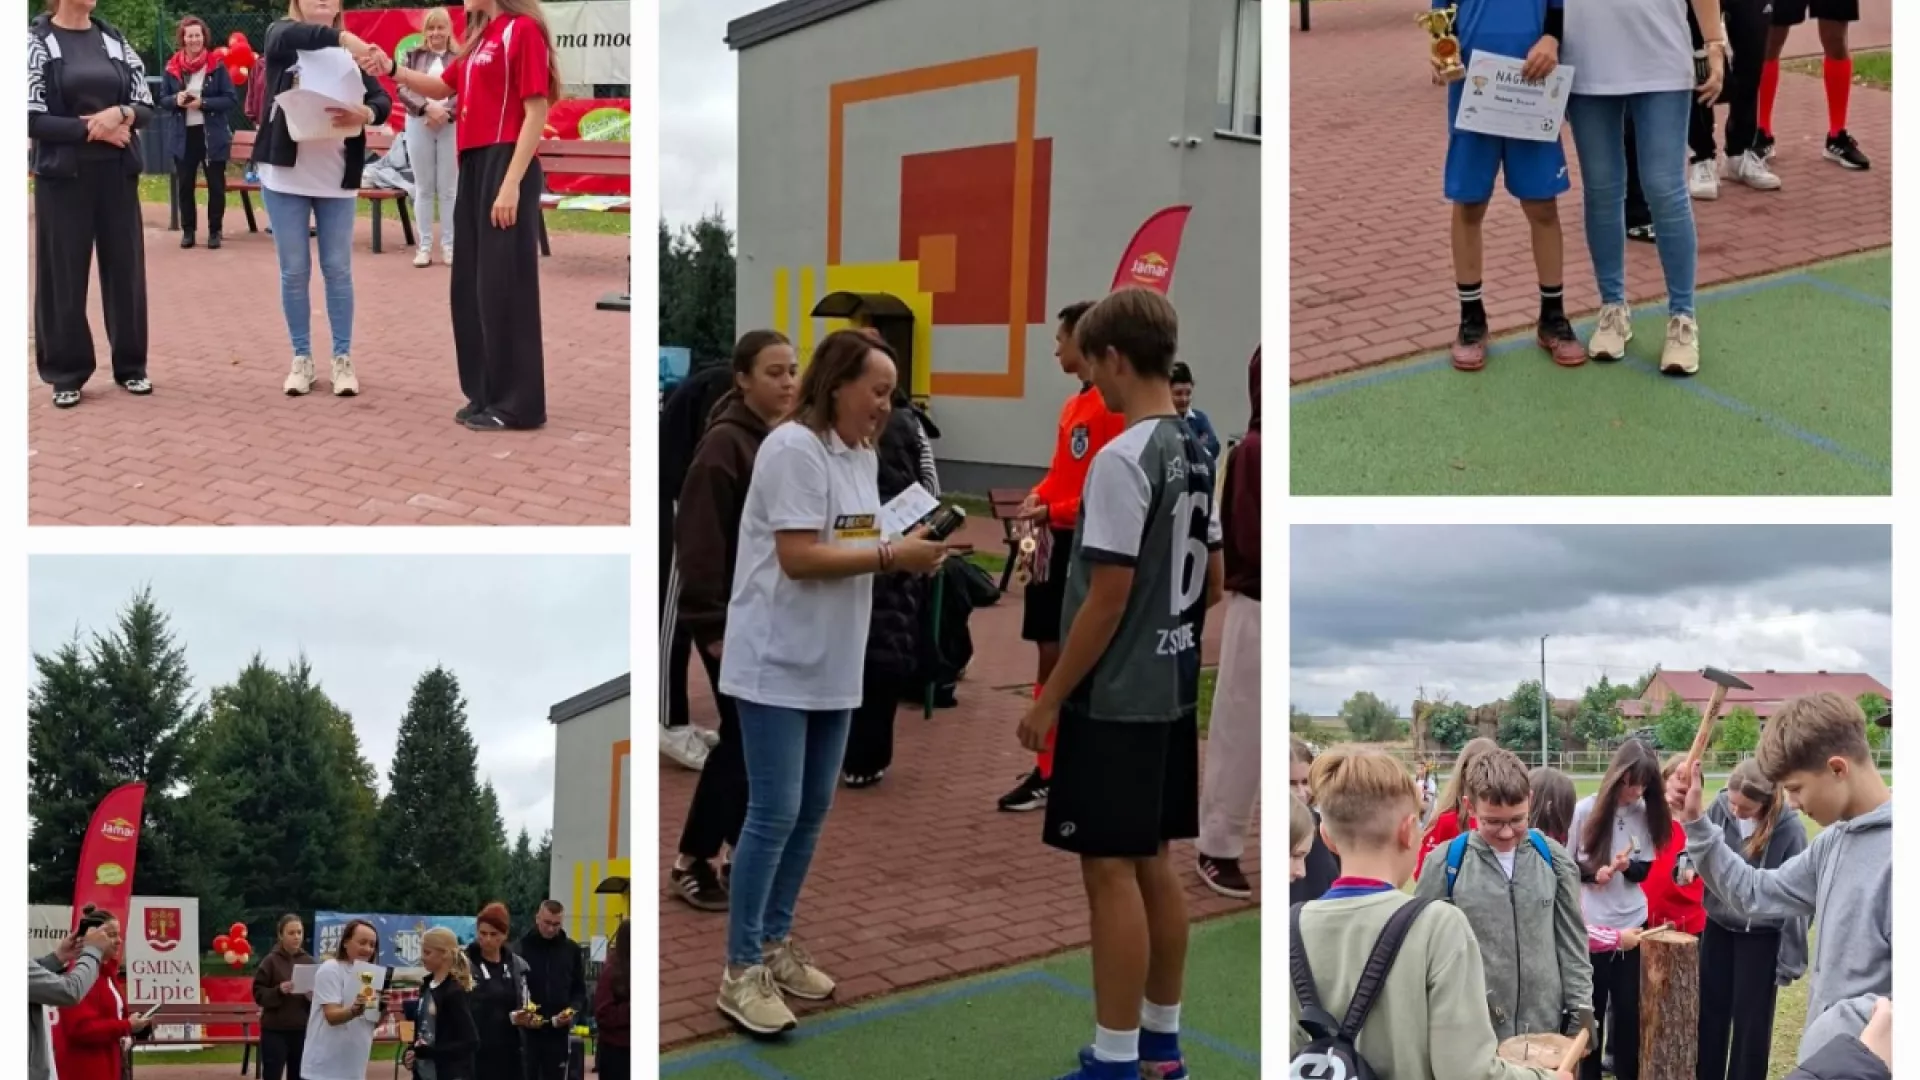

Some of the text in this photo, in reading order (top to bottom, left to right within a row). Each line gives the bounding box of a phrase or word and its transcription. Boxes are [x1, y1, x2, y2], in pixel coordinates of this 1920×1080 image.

[556, 33, 588, 48] ma
[1131, 258, 1168, 277] Jamar
[101, 821, 135, 837] Jamar
[132, 960, 194, 975] GMINA
[133, 977, 195, 1005] Lipie
